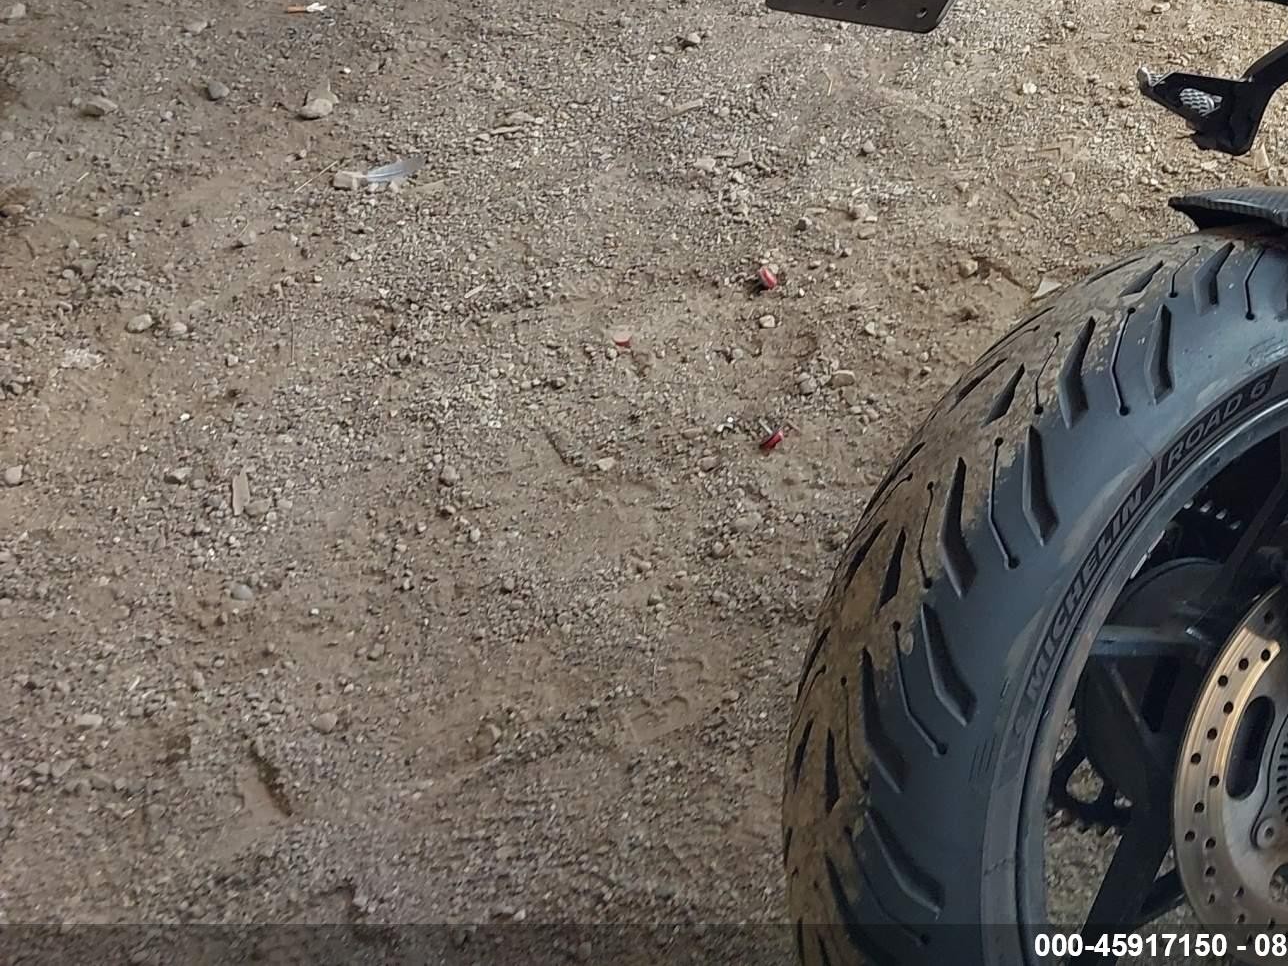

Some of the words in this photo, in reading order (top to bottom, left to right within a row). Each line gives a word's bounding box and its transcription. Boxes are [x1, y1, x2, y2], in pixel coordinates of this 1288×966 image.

[1025, 484, 1145, 706] MICHELIN
[1166, 399, 1244, 470] ROAD
[1252, 378, 1272, 399] 6
